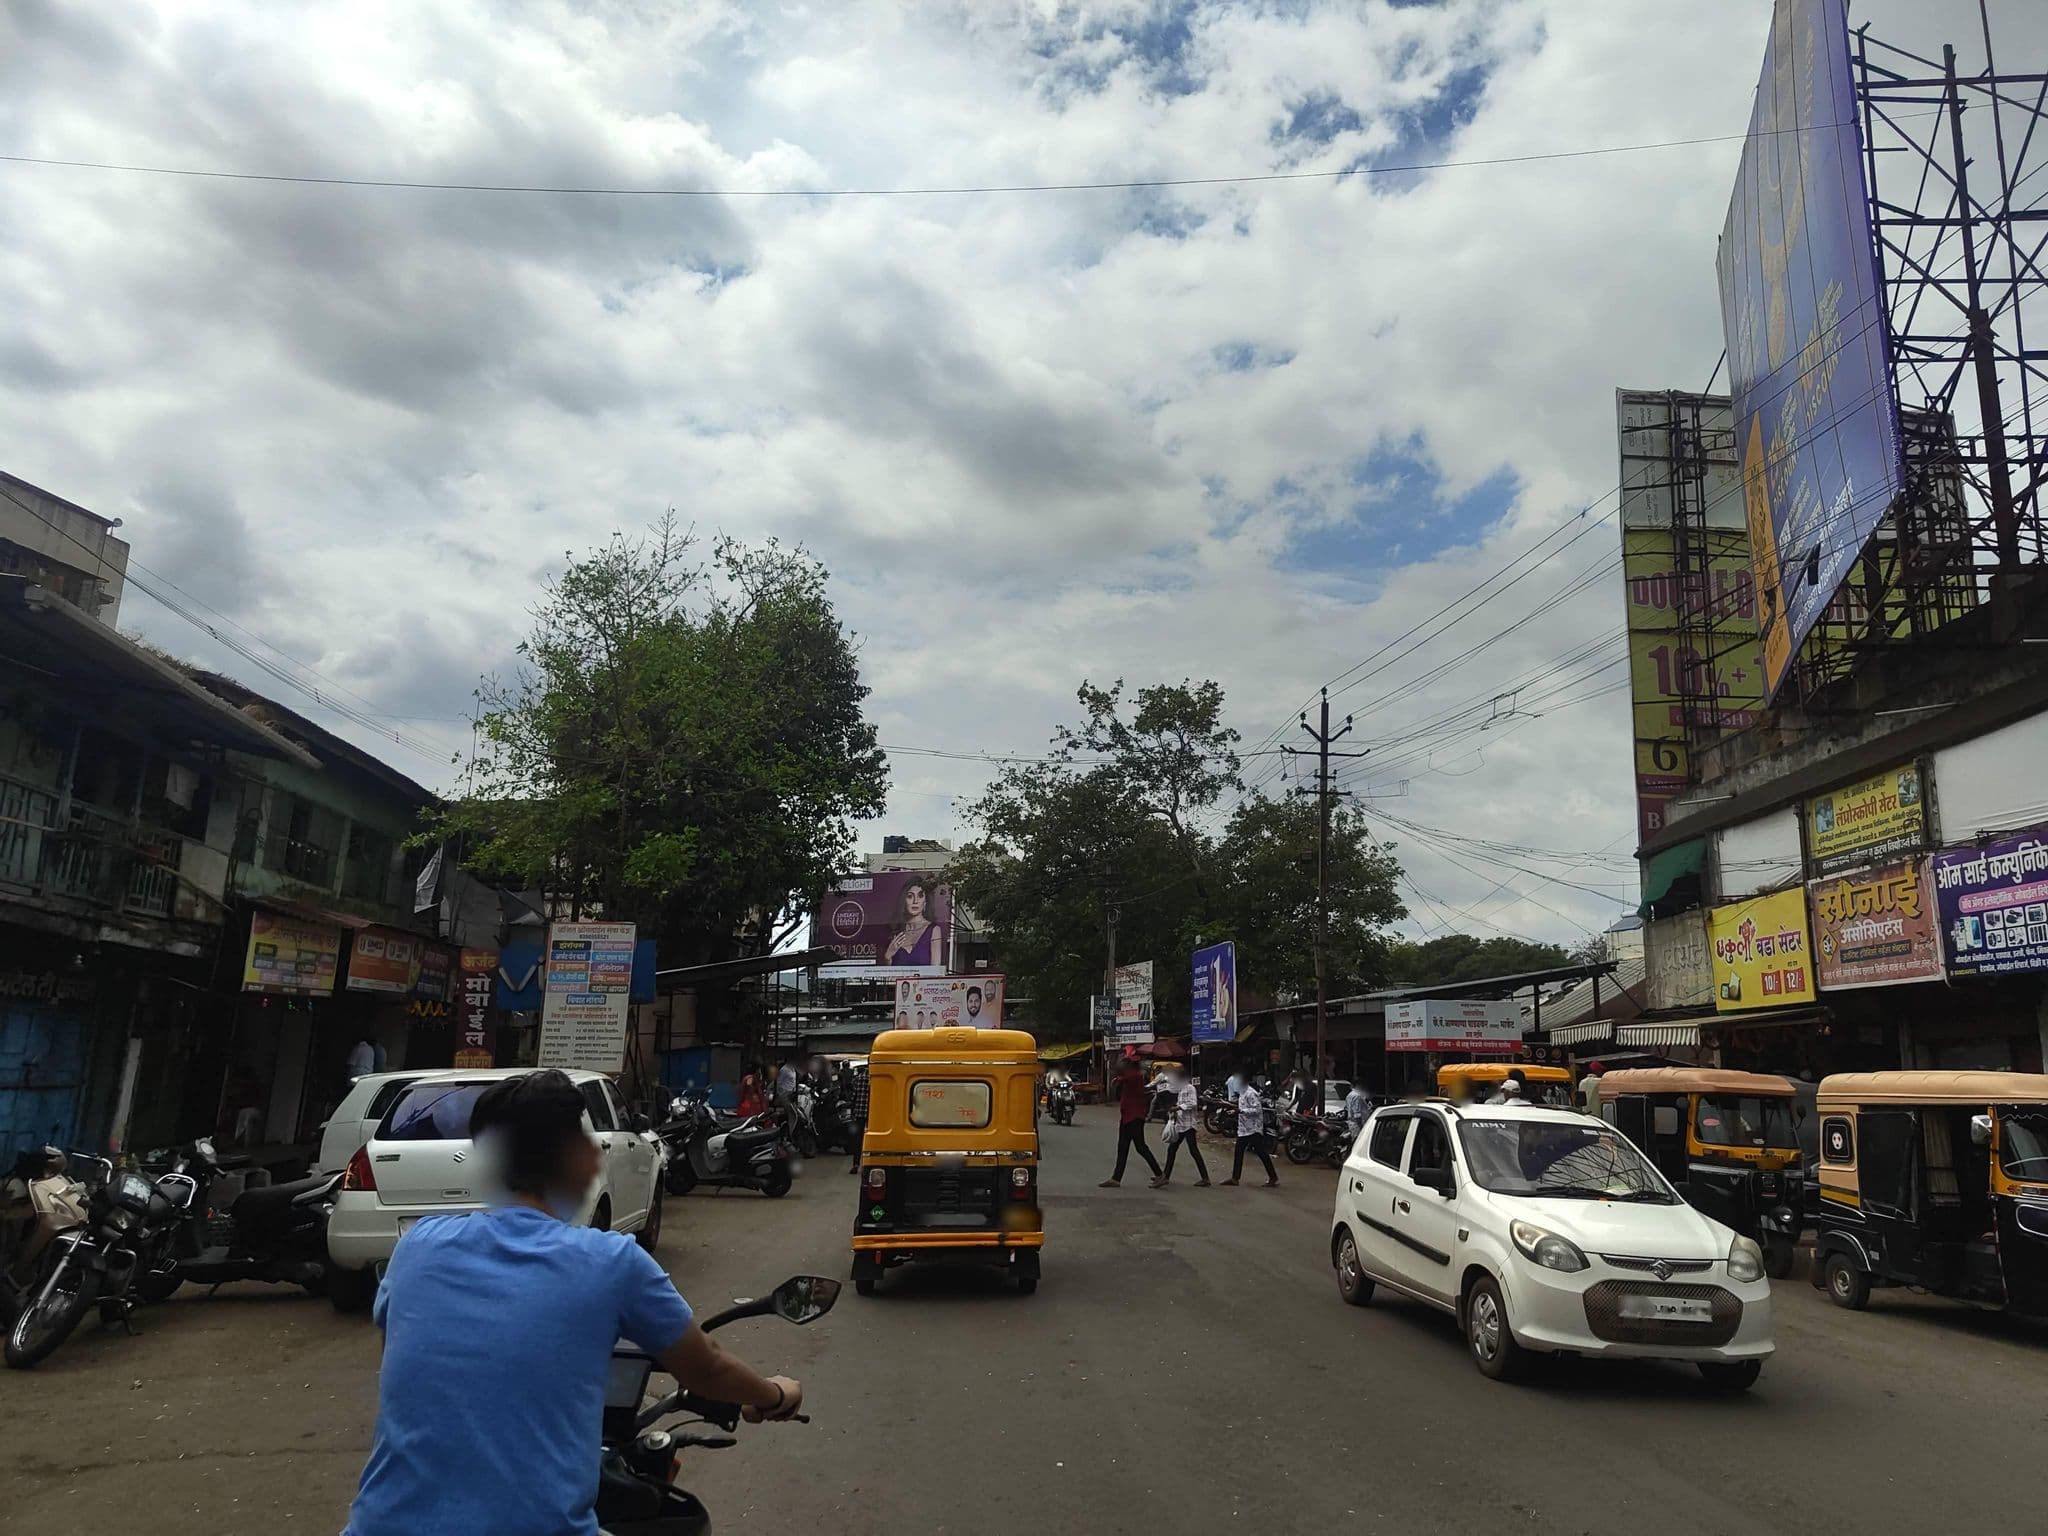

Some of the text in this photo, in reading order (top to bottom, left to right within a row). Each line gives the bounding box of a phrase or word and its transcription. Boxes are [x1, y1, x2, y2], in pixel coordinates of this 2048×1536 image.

[1937, 859, 1962, 889] ओम
[1963, 851, 1988, 885] साई
[1819, 857, 1923, 924] सोनाई
[1756, 935, 1776, 956] वडा
